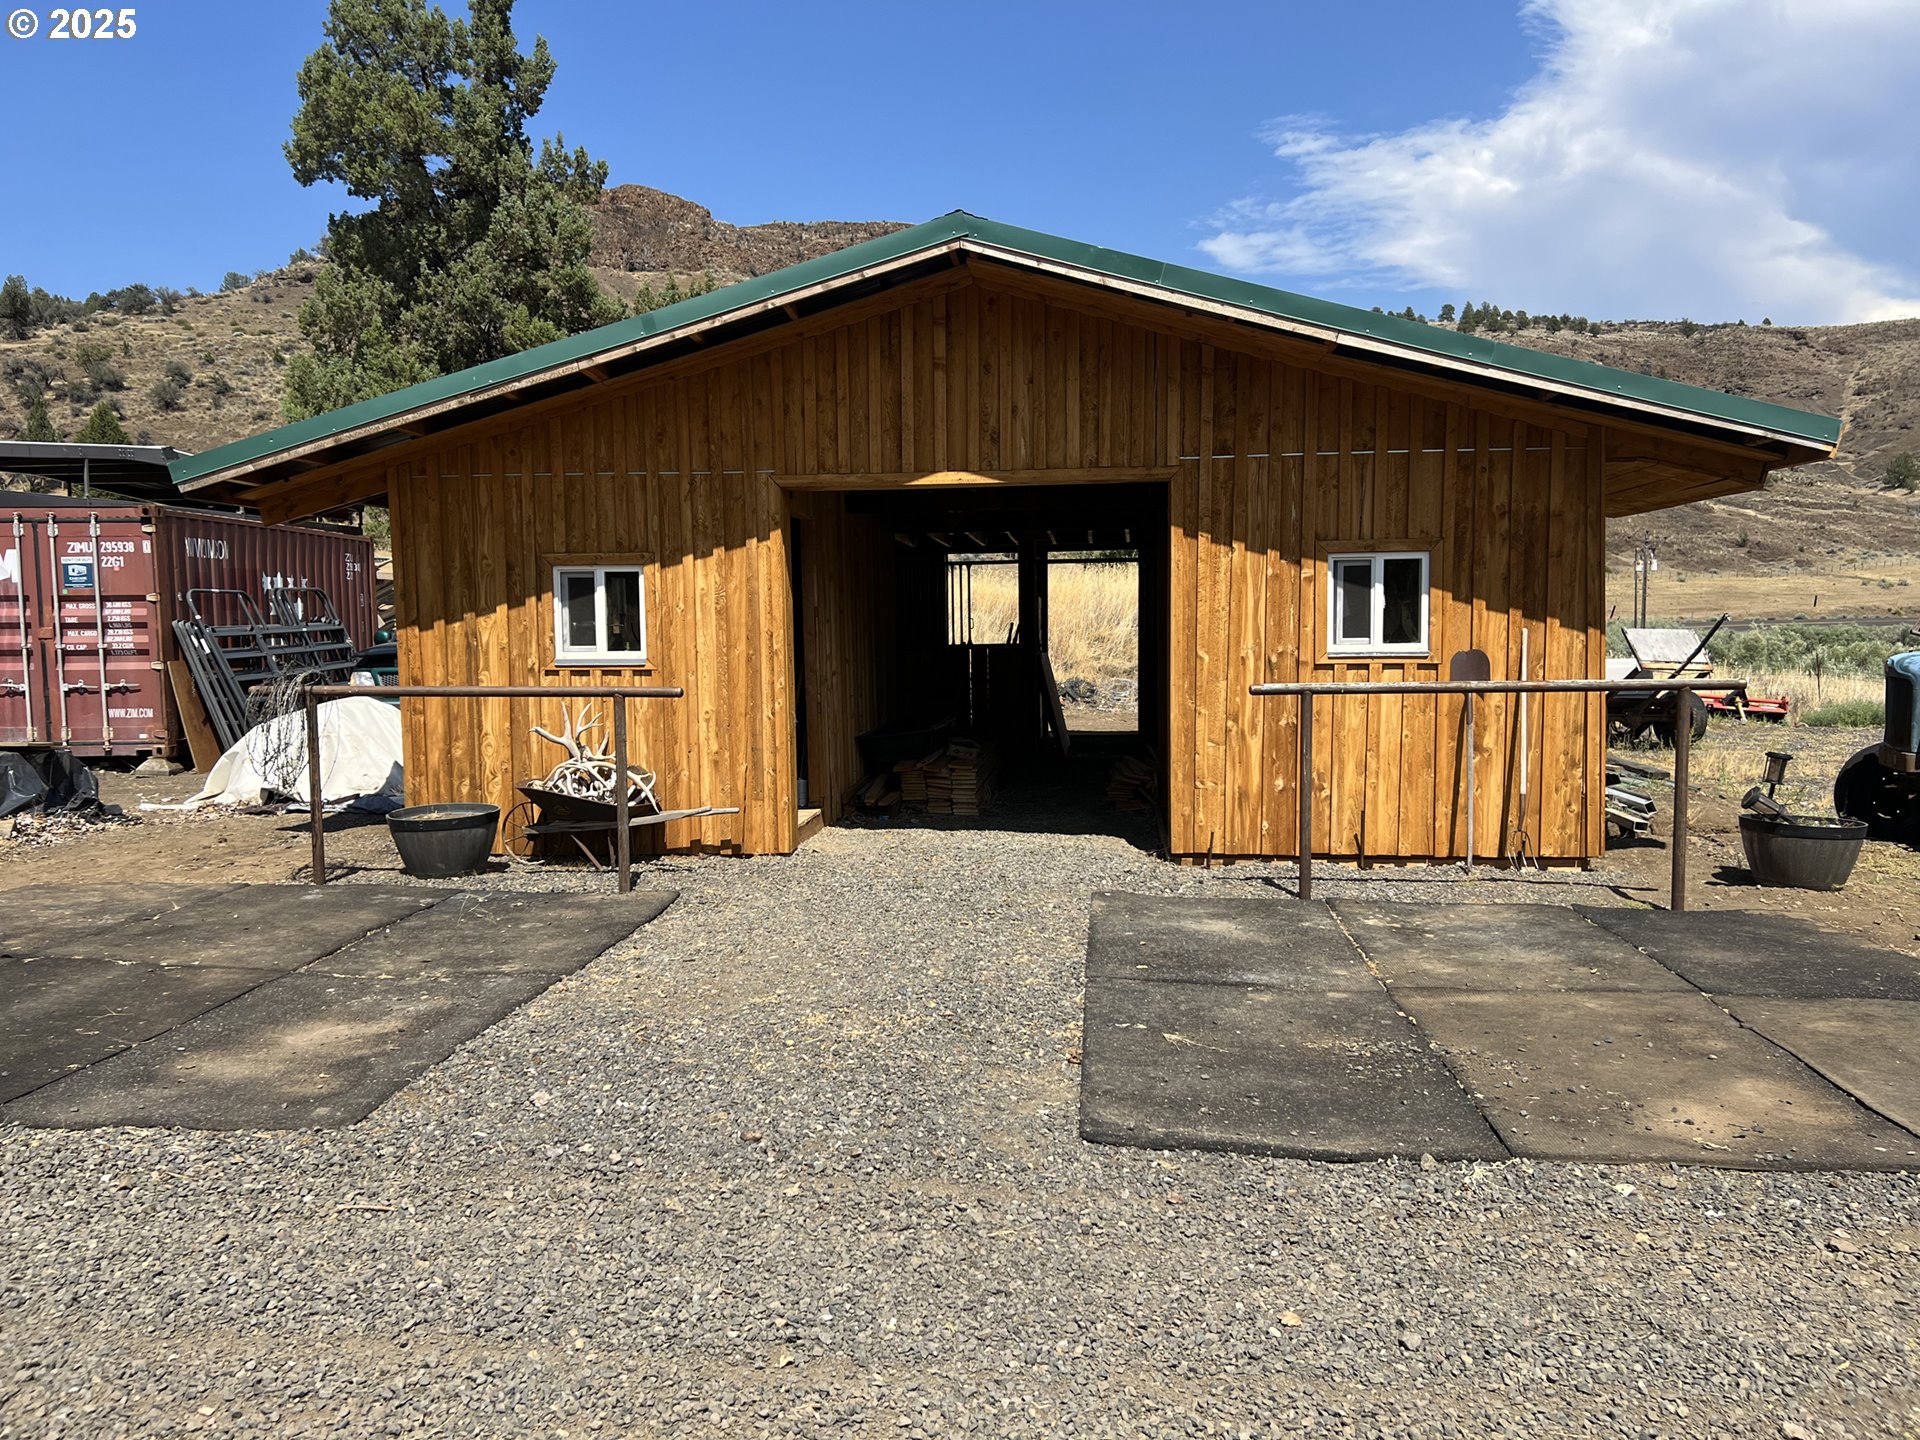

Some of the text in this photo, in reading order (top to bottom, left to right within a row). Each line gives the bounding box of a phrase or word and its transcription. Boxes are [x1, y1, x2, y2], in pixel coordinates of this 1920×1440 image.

[67, 542, 93, 553] ZIMU
[100, 541, 135, 553] 295938
[101, 556, 124, 567] 22G1
[108, 708, 154, 718] WWW.ZIM.COM
